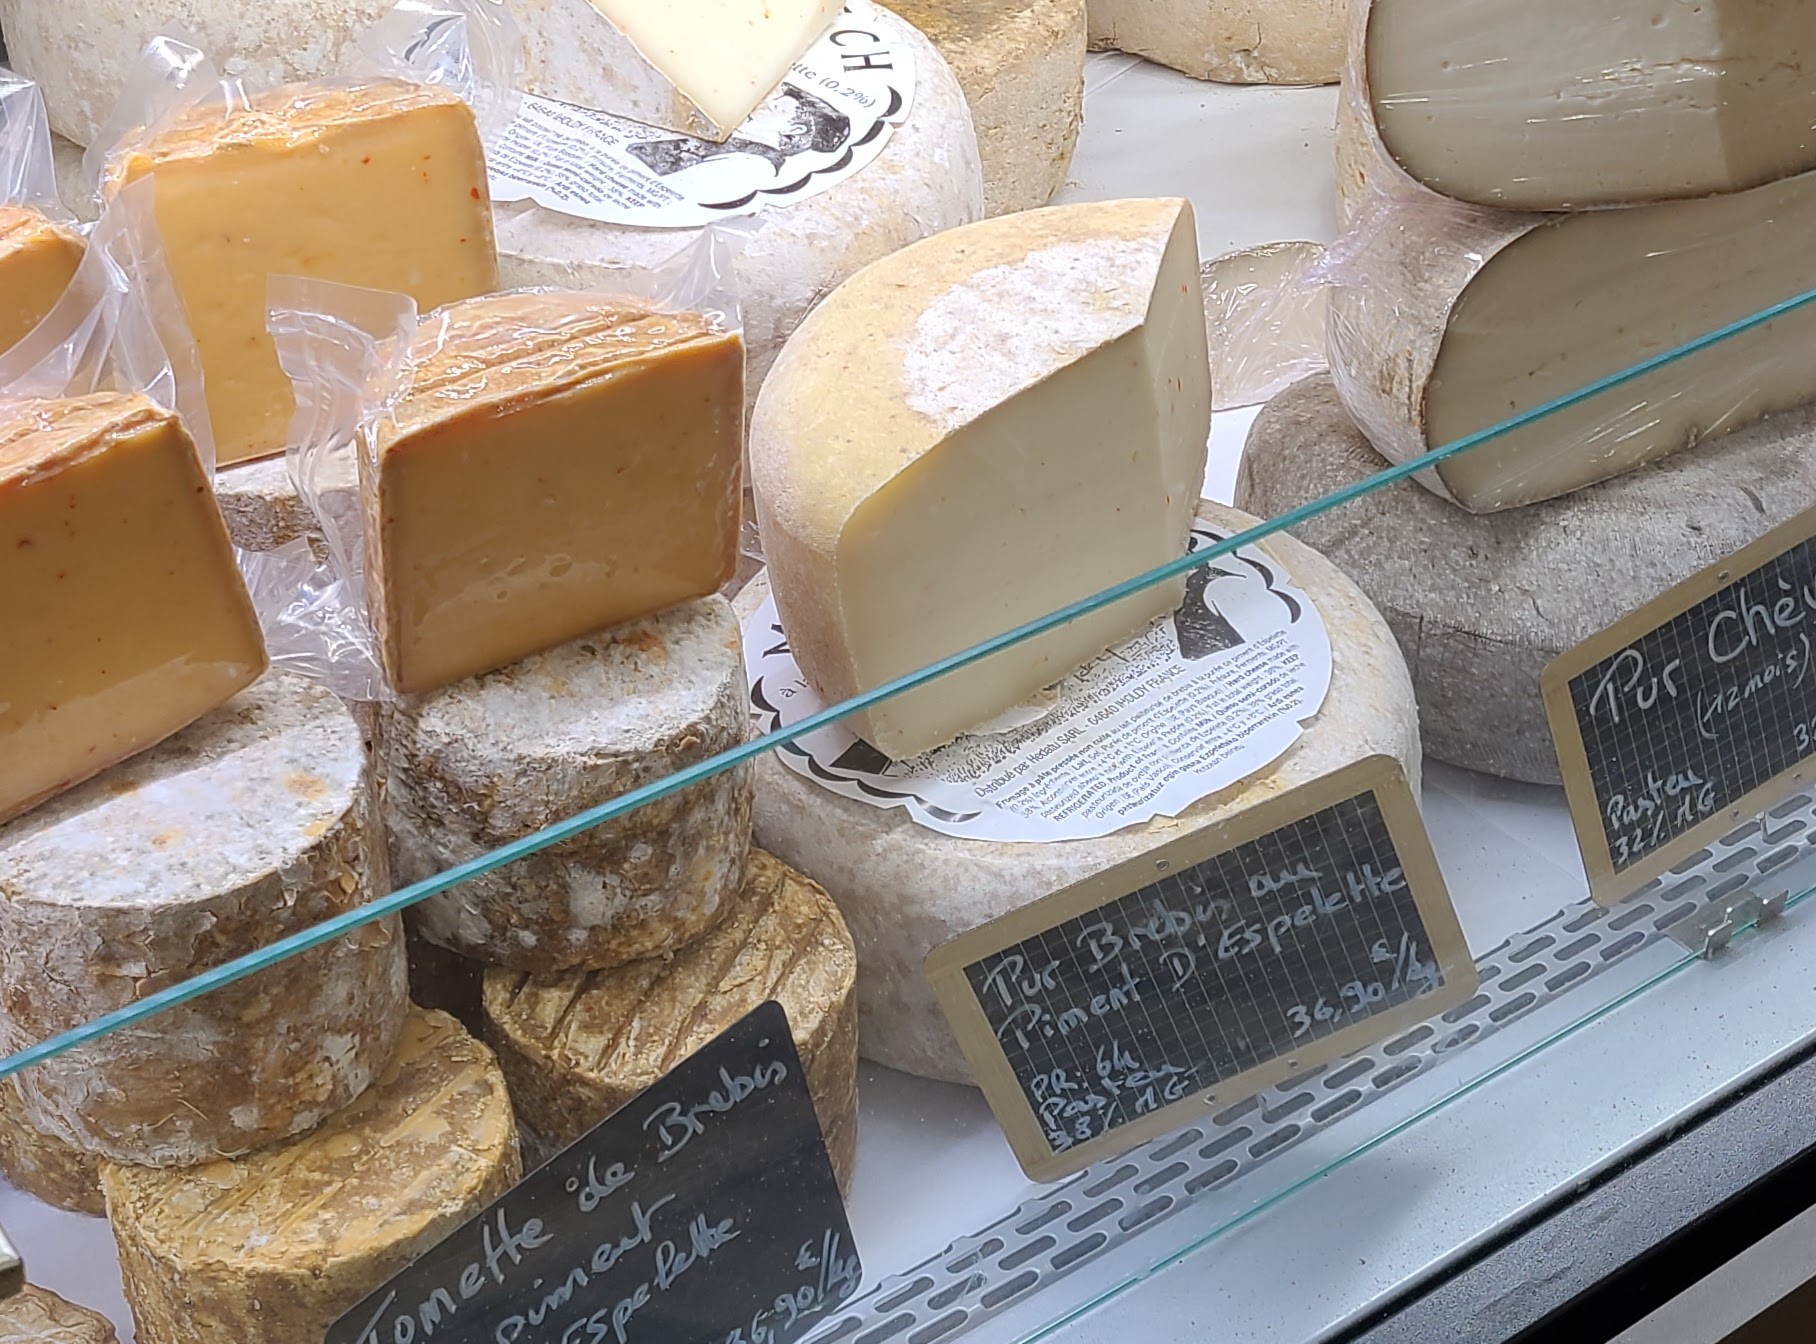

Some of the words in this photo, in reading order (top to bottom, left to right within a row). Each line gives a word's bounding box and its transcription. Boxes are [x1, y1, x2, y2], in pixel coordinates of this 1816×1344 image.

[1589, 649, 1680, 723] Pur
[982, 954, 1060, 1006] Pur
[1250, 862, 1323, 898] au
[997, 963, 1141, 1049] Piment
[578, 1155, 635, 1212] de
